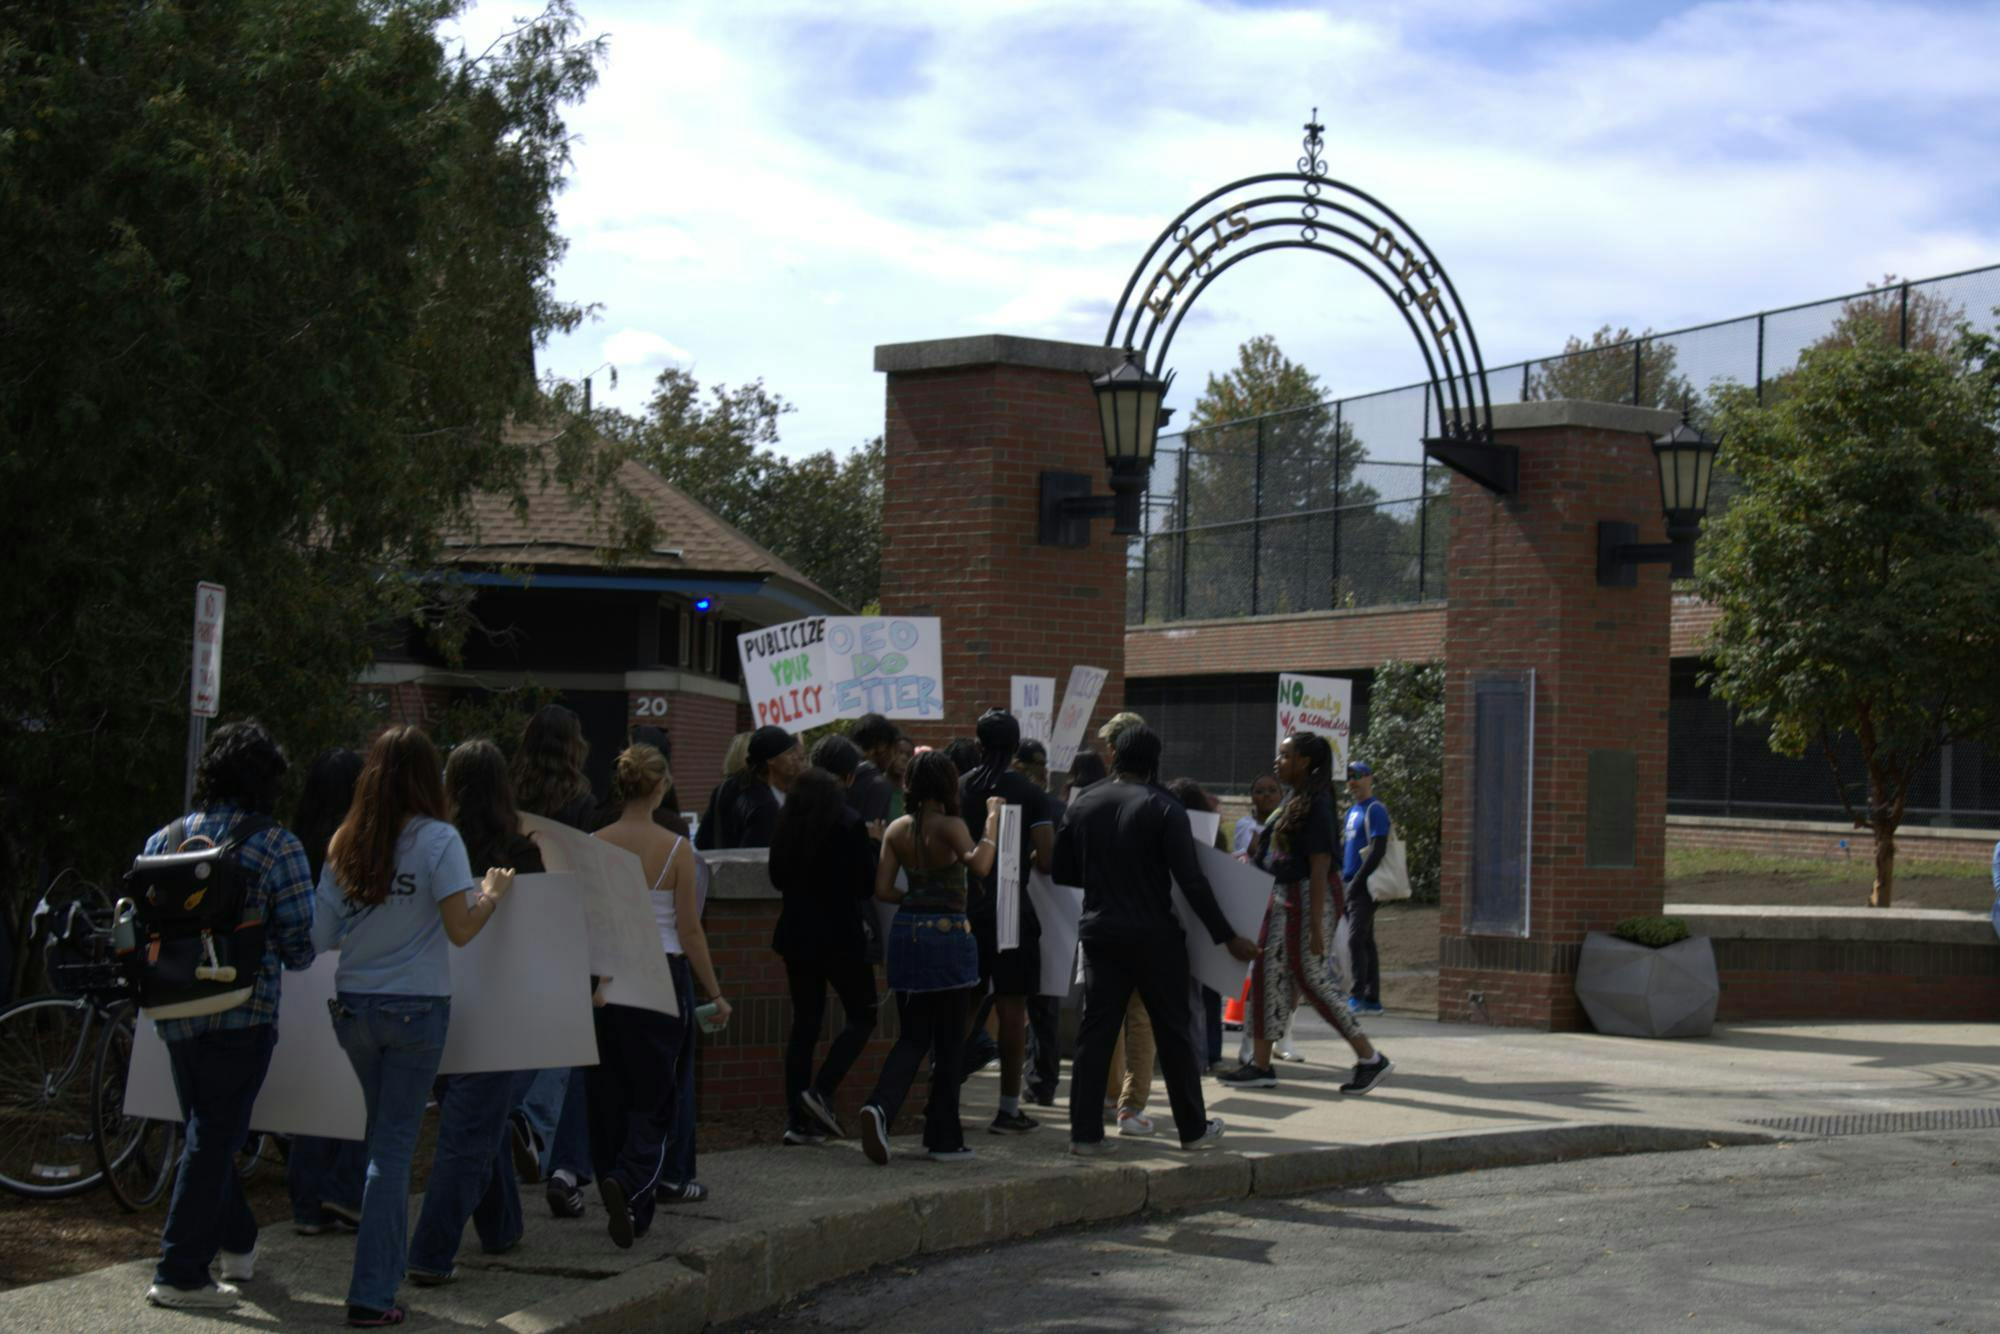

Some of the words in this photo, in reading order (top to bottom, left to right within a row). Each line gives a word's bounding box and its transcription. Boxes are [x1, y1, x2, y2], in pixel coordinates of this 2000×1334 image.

[1143, 203, 1251, 325] ELLIS
[1373, 227, 1457, 357] OVAL
[744, 618, 826, 663] PUBLICIZE
[828, 619, 919, 656] OEO
[769, 652, 813, 688] YOUR
[852, 652, 909, 678] DO
[635, 696, 668, 716] 20
[757, 684, 823, 727] POLICY
[830, 675, 944, 715] ETTER
[1279, 680, 1304, 708] NO
